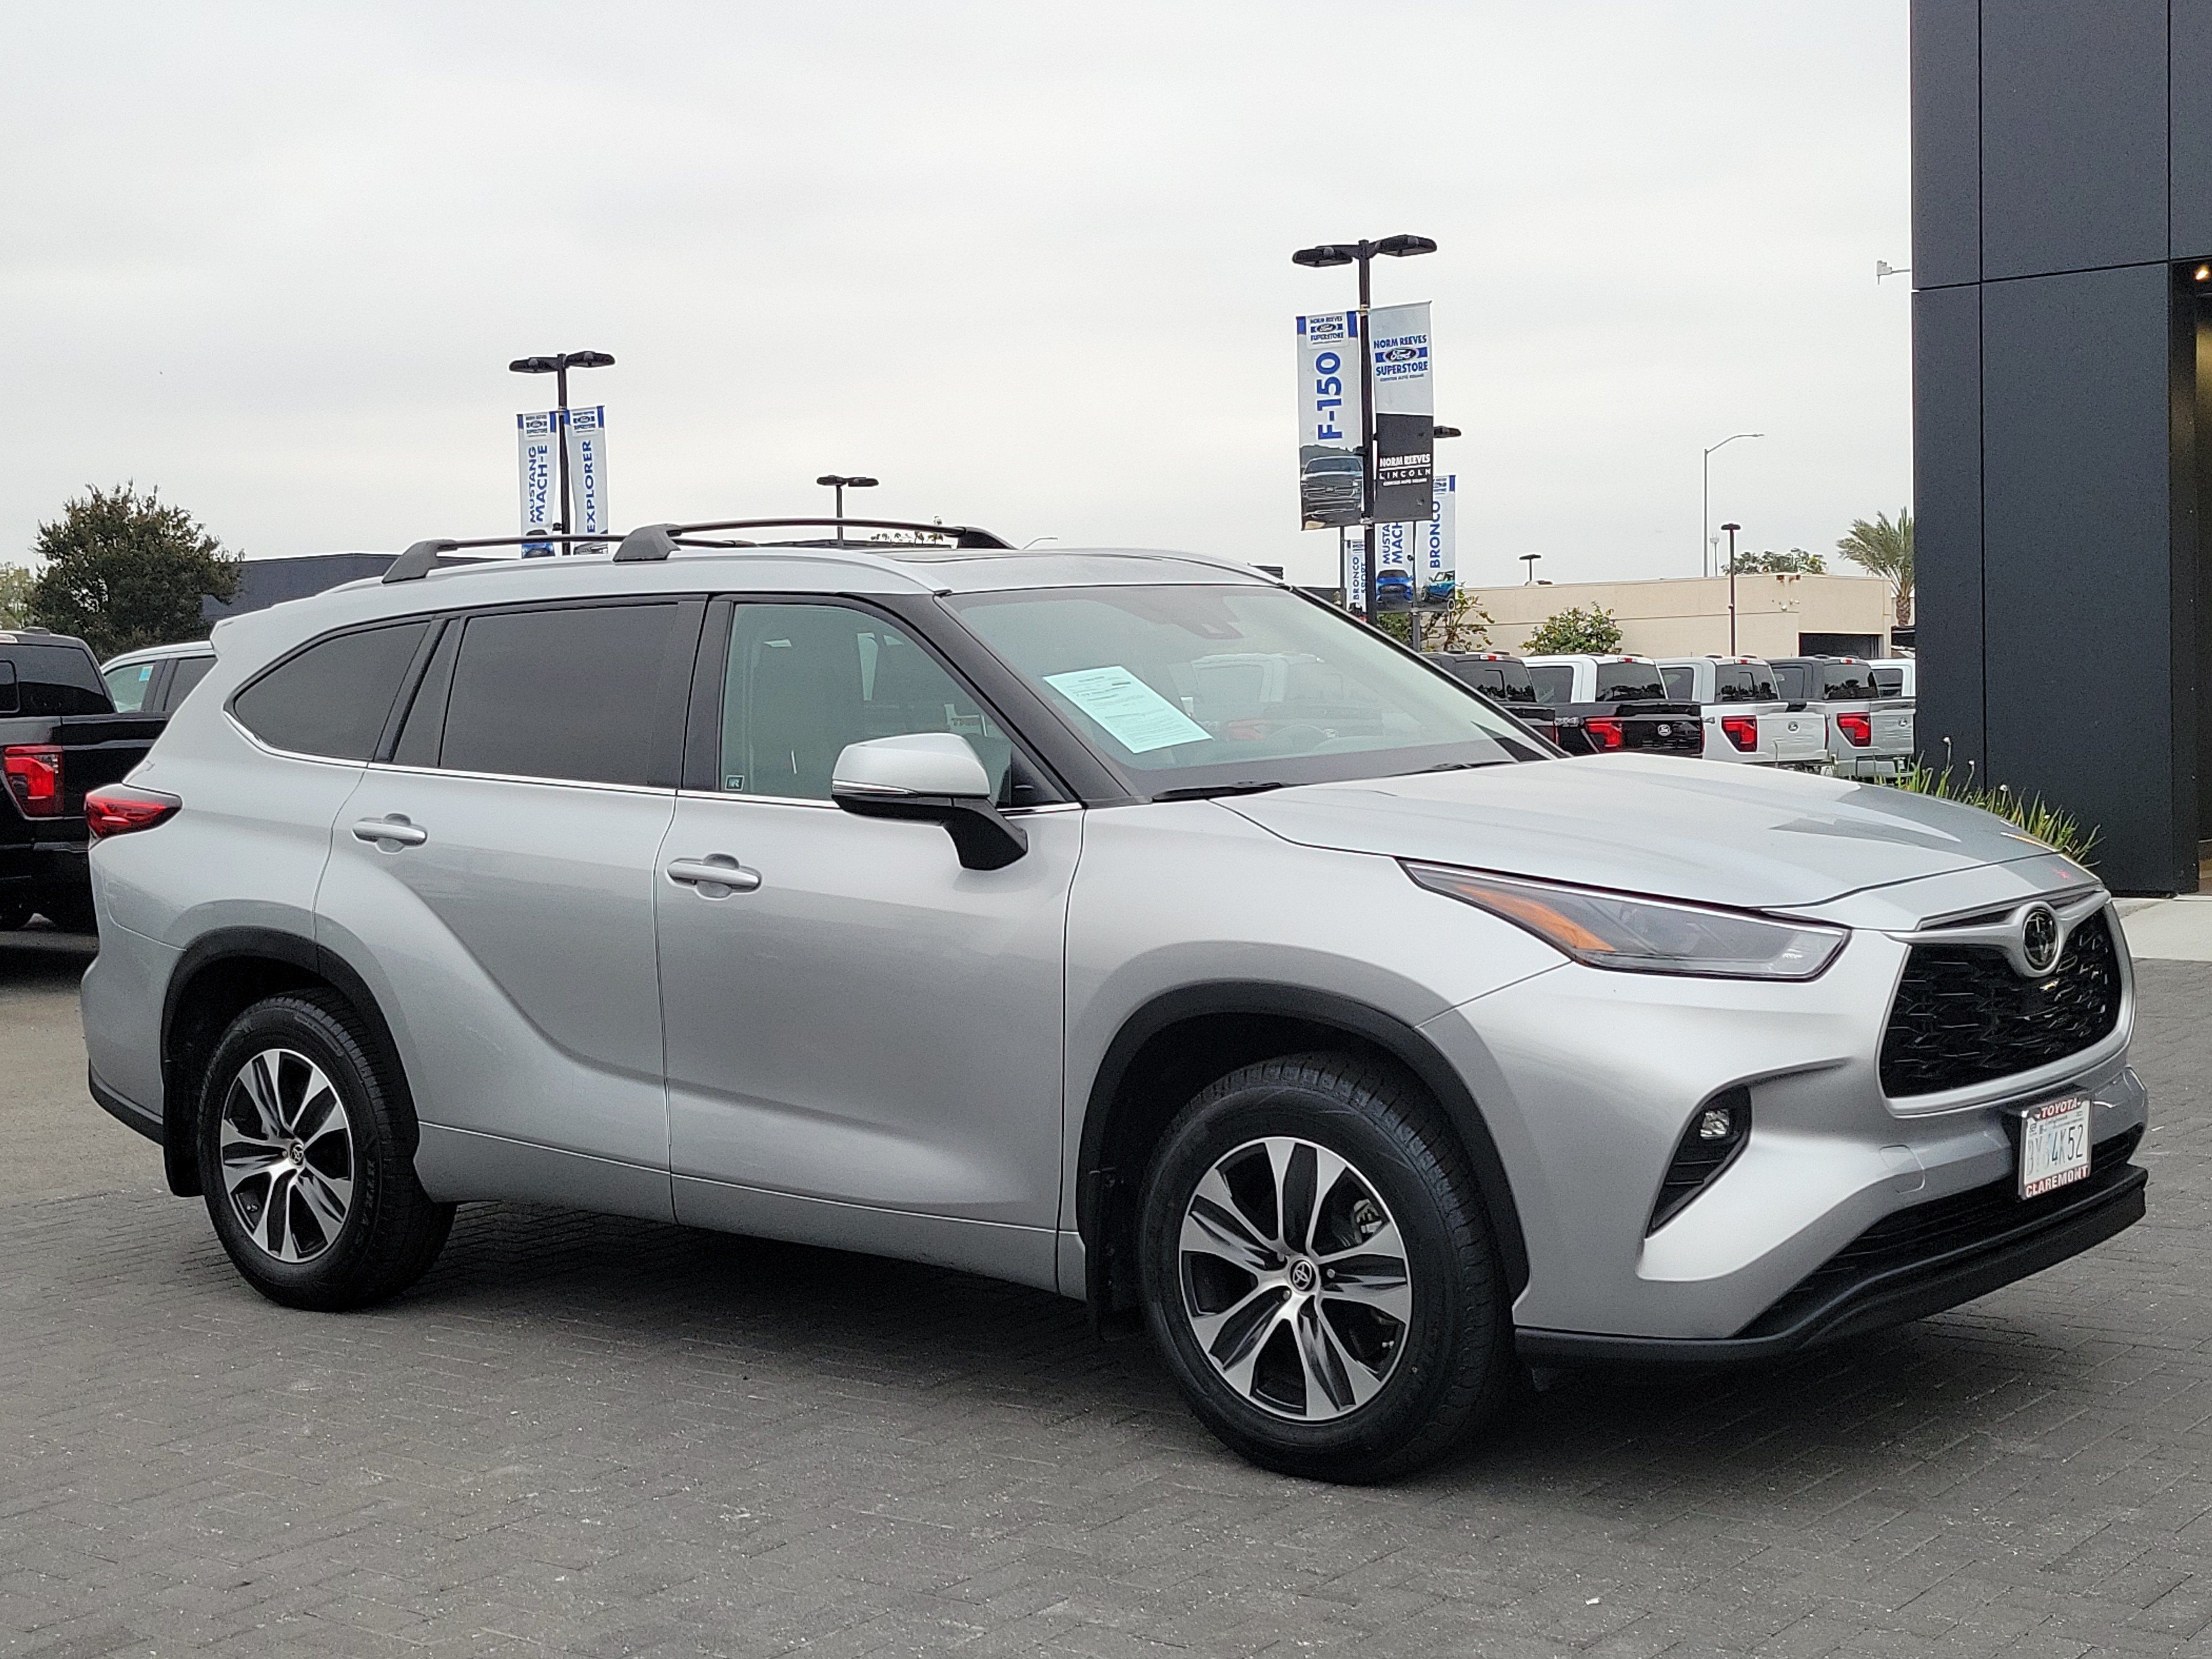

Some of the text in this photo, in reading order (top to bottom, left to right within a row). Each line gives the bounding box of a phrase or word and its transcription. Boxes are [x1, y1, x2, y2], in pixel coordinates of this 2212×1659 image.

[1373, 334, 1426, 349] NORM REEVES
[1375, 361, 1428, 376] SUPERSTORE
[1316, 352, 1342, 440] F-150
[1379, 453, 1431, 467] NORM REEVES
[1379, 468, 1431, 480] LINCOLN
[528, 446, 537, 523] MUSTANG
[535, 445, 548, 522] MACH-E
[582, 440, 596, 533] EXPLORER
[1382, 524, 1390, 565] MUSTA
[1392, 522, 1403, 565] MACH
[1429, 500, 1441, 568] BRONCO
[2041, 1098, 2077, 1118] TOYOTA
[2025, 1165, 2088, 1198] CLAREMONT
